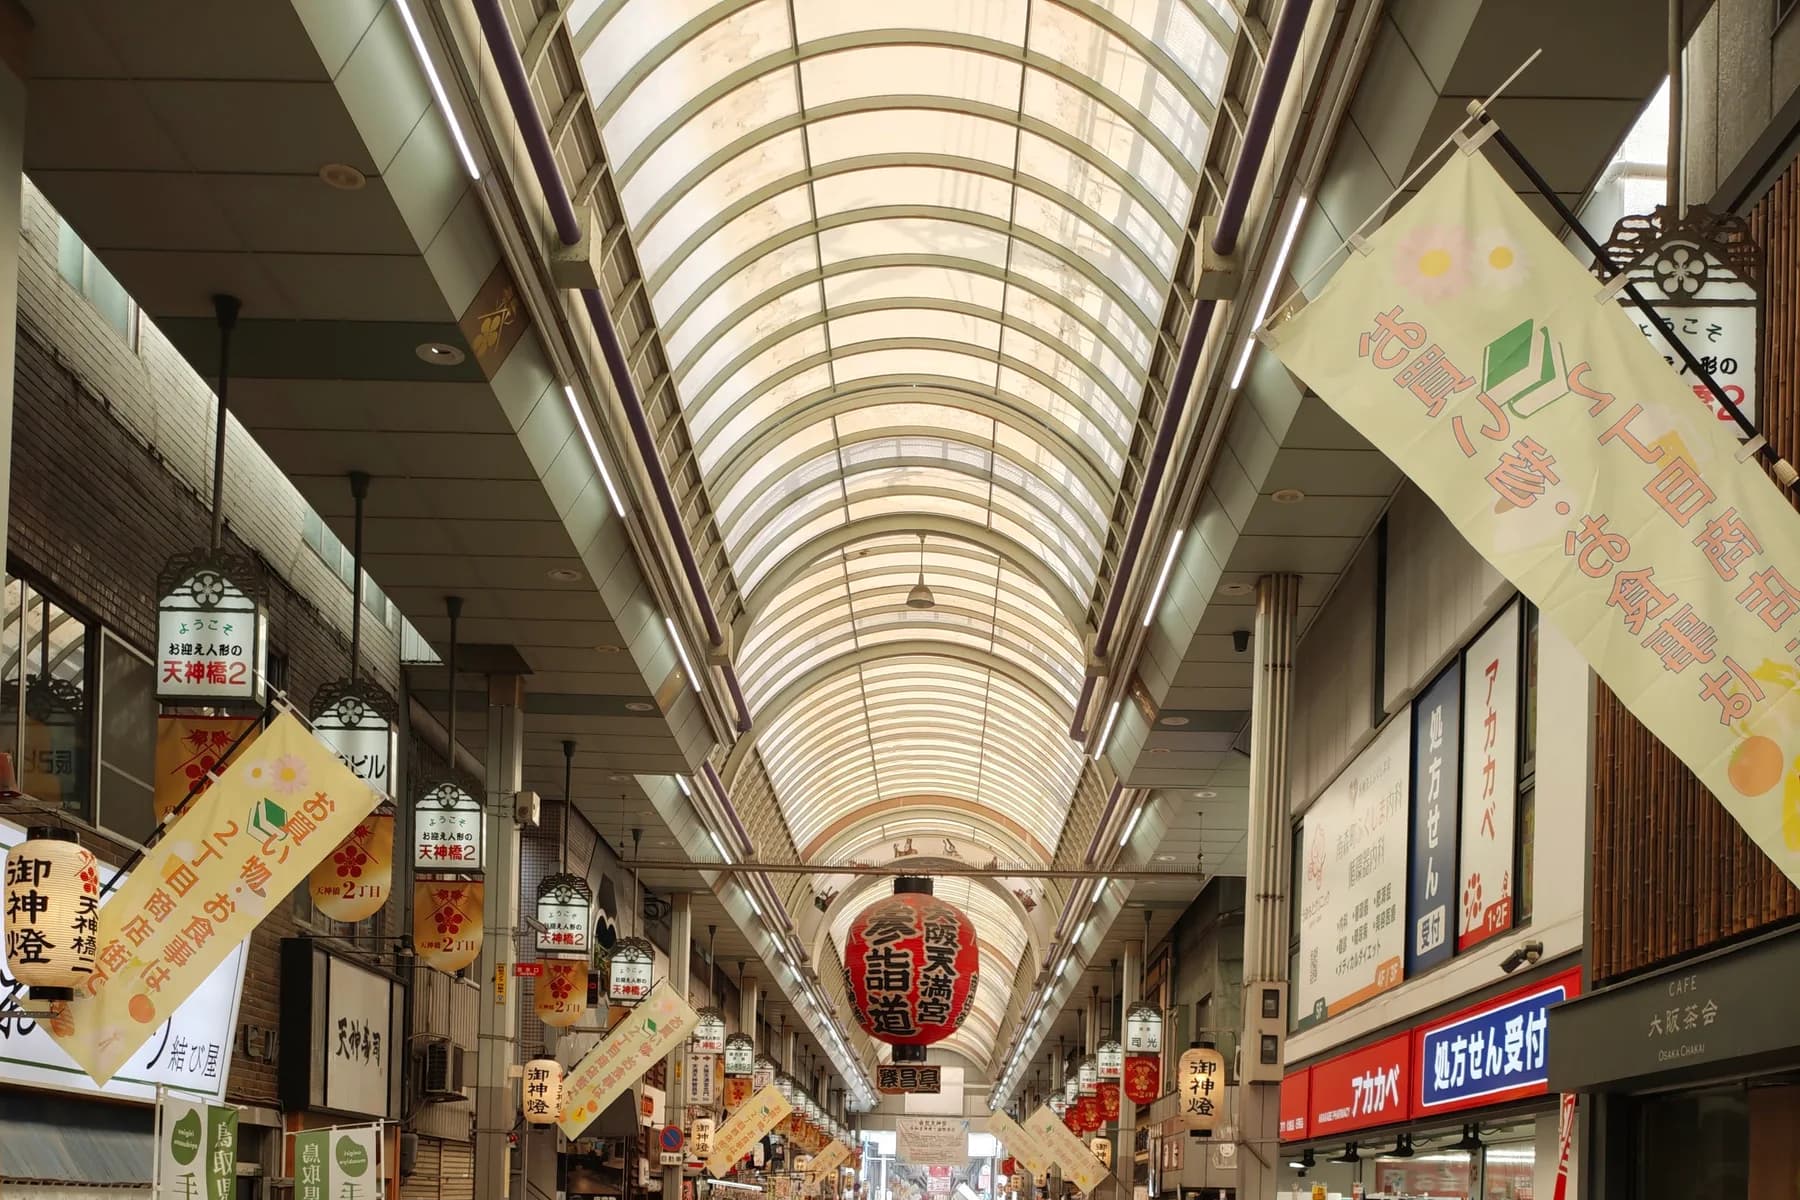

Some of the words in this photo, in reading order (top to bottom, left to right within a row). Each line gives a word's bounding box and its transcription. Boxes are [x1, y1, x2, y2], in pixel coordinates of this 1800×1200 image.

[179, 619, 233, 636] ようこそ
[169, 643, 242, 656] お迎え人形の
[163, 660, 247, 685] 天神橋2
[1481, 658, 1499, 841] アカカベ
[429, 815, 466, 827] ようこそ
[1425, 705, 1443, 901] 処方せん
[419, 844, 476, 861] 天神橋2
[422, 832, 473, 841] お迎え人形の
[7, 855, 56, 965] 御神燈
[87, 818, 240, 997] 2丁目商店街で
[139, 790, 336, 994] お買い物・お食事は
[70, 895, 99, 974] 天神橋二
[540, 932, 585, 946] 天神橋2
[1420, 912, 1442, 949] 受付
[917, 906, 962, 1024] 大阪天満宮
[1668, 975, 1697, 997] CAFE
[612, 985, 648, 996] 天神橋2
[1648, 1000, 1718, 1038] 大阪茶会
[168, 1035, 220, 1078] 結び屋
[1434, 1007, 1547, 1091] 処方せん受付
[527, 1067, 550, 1115] 御神燈
[1187, 1059, 1217, 1117] 御神燈
[1351, 1064, 1400, 1118] アカカベ
